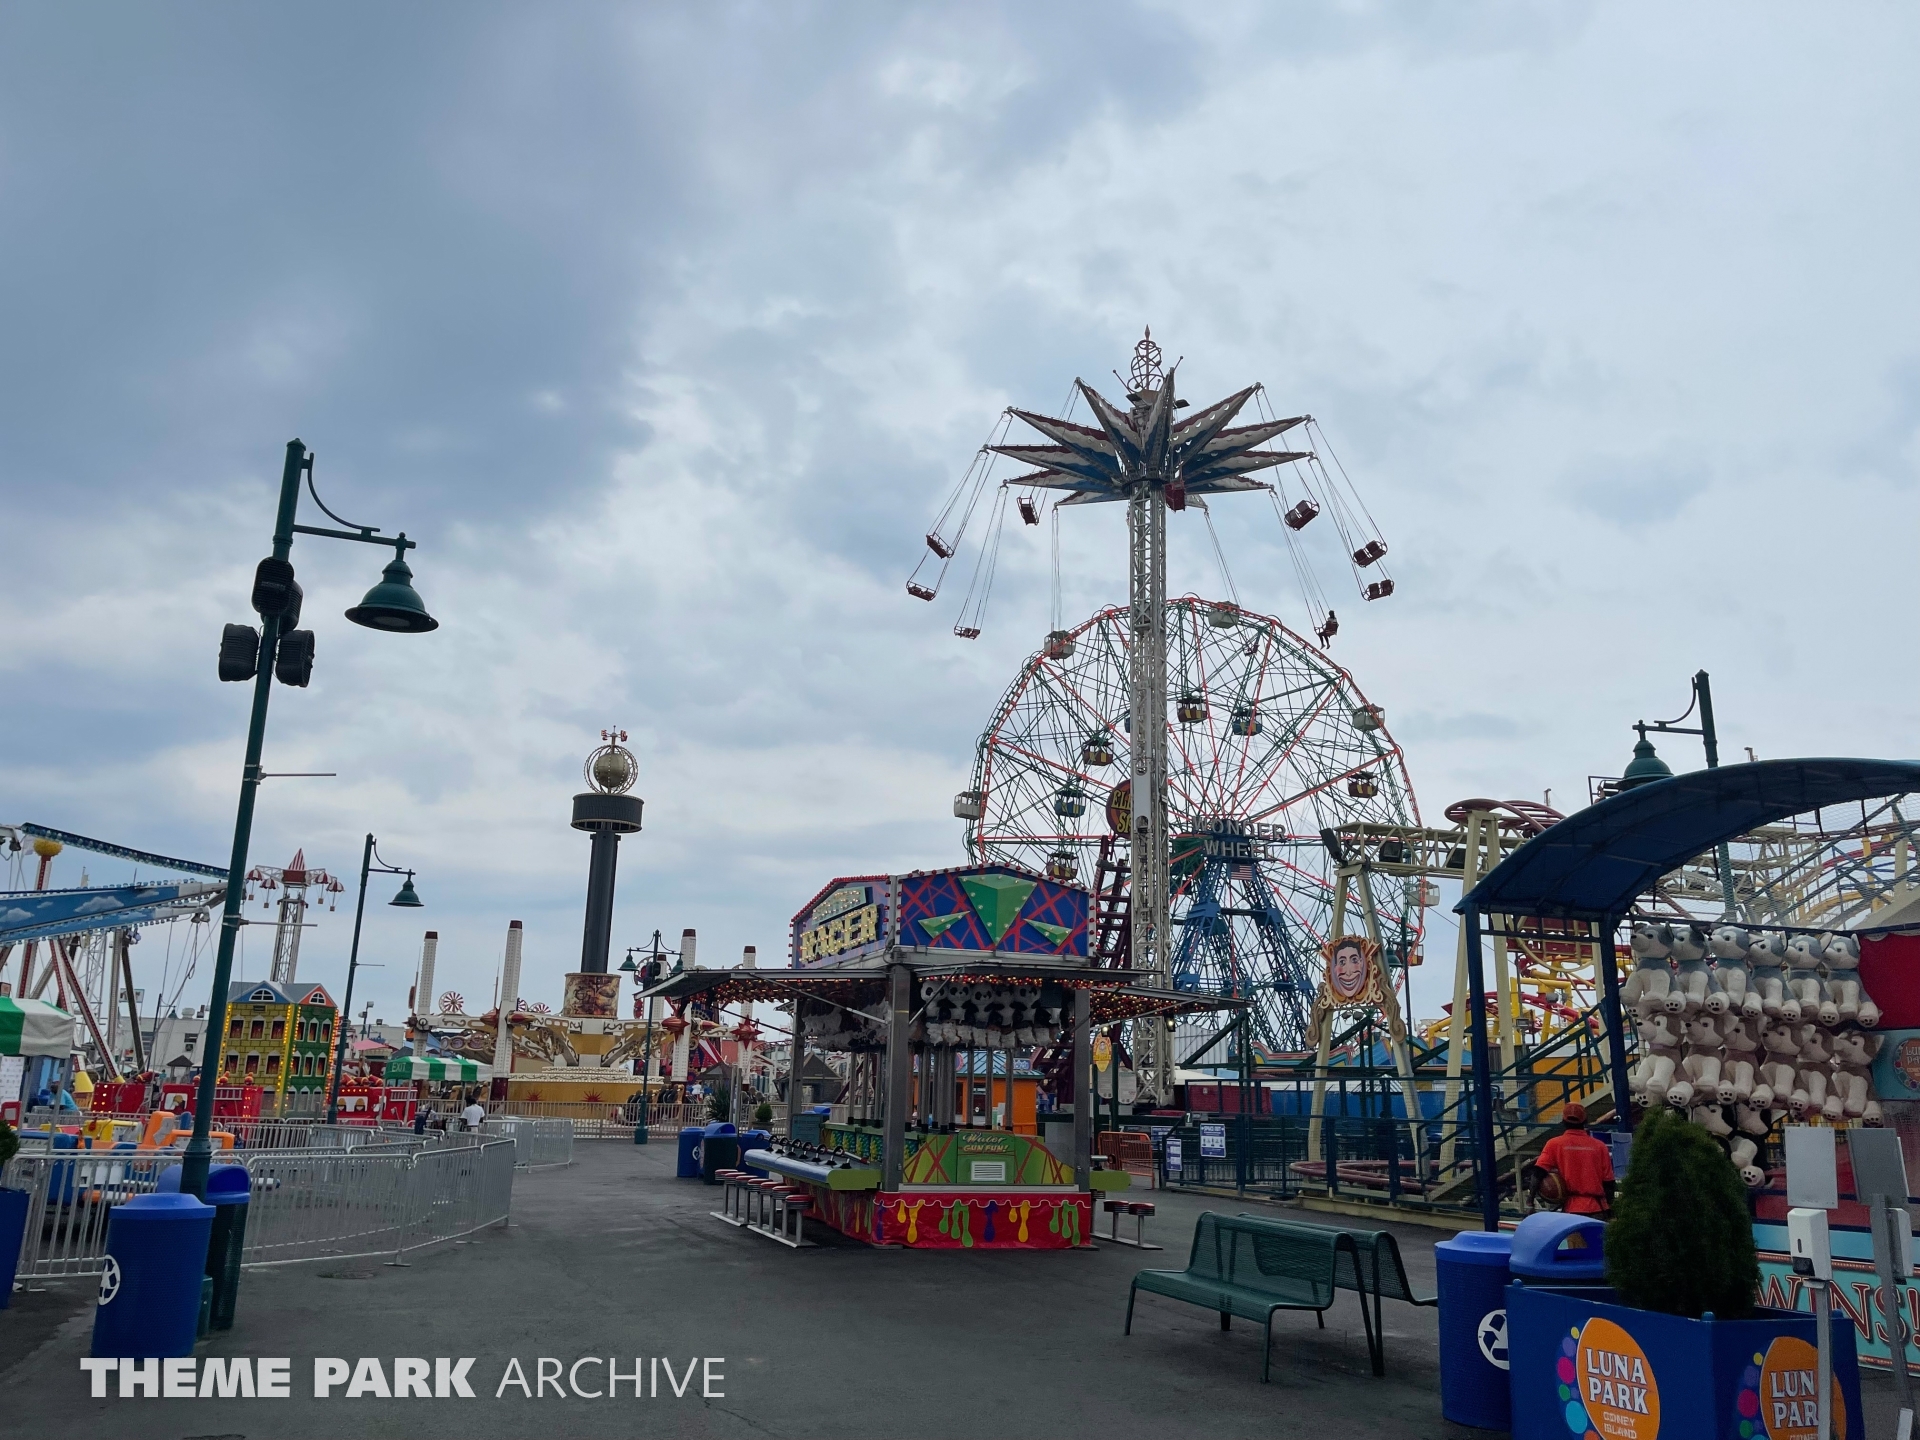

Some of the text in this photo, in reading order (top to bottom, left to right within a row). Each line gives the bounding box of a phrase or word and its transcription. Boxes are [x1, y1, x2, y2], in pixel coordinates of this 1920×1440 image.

[1192, 816, 1286, 840] WONDER
[1203, 840, 1275, 859] WHEEL
[799, 904, 877, 963] RACER
[393, 1062, 406, 1072] EXIT
[1186, 1112, 1191, 1123] 7
[962, 1132, 1006, 1143] Water
[963, 1144, 983, 1152] GUN
[1586, 1348, 1647, 1384] LUNA
[1770, 1370, 1815, 1398] LUN
[1588, 1377, 1649, 1414] PARK
[1603, 1411, 1635, 1427] CONEY
[1773, 1400, 1818, 1428] PAR
[1604, 1423, 1637, 1439] ISLAND
